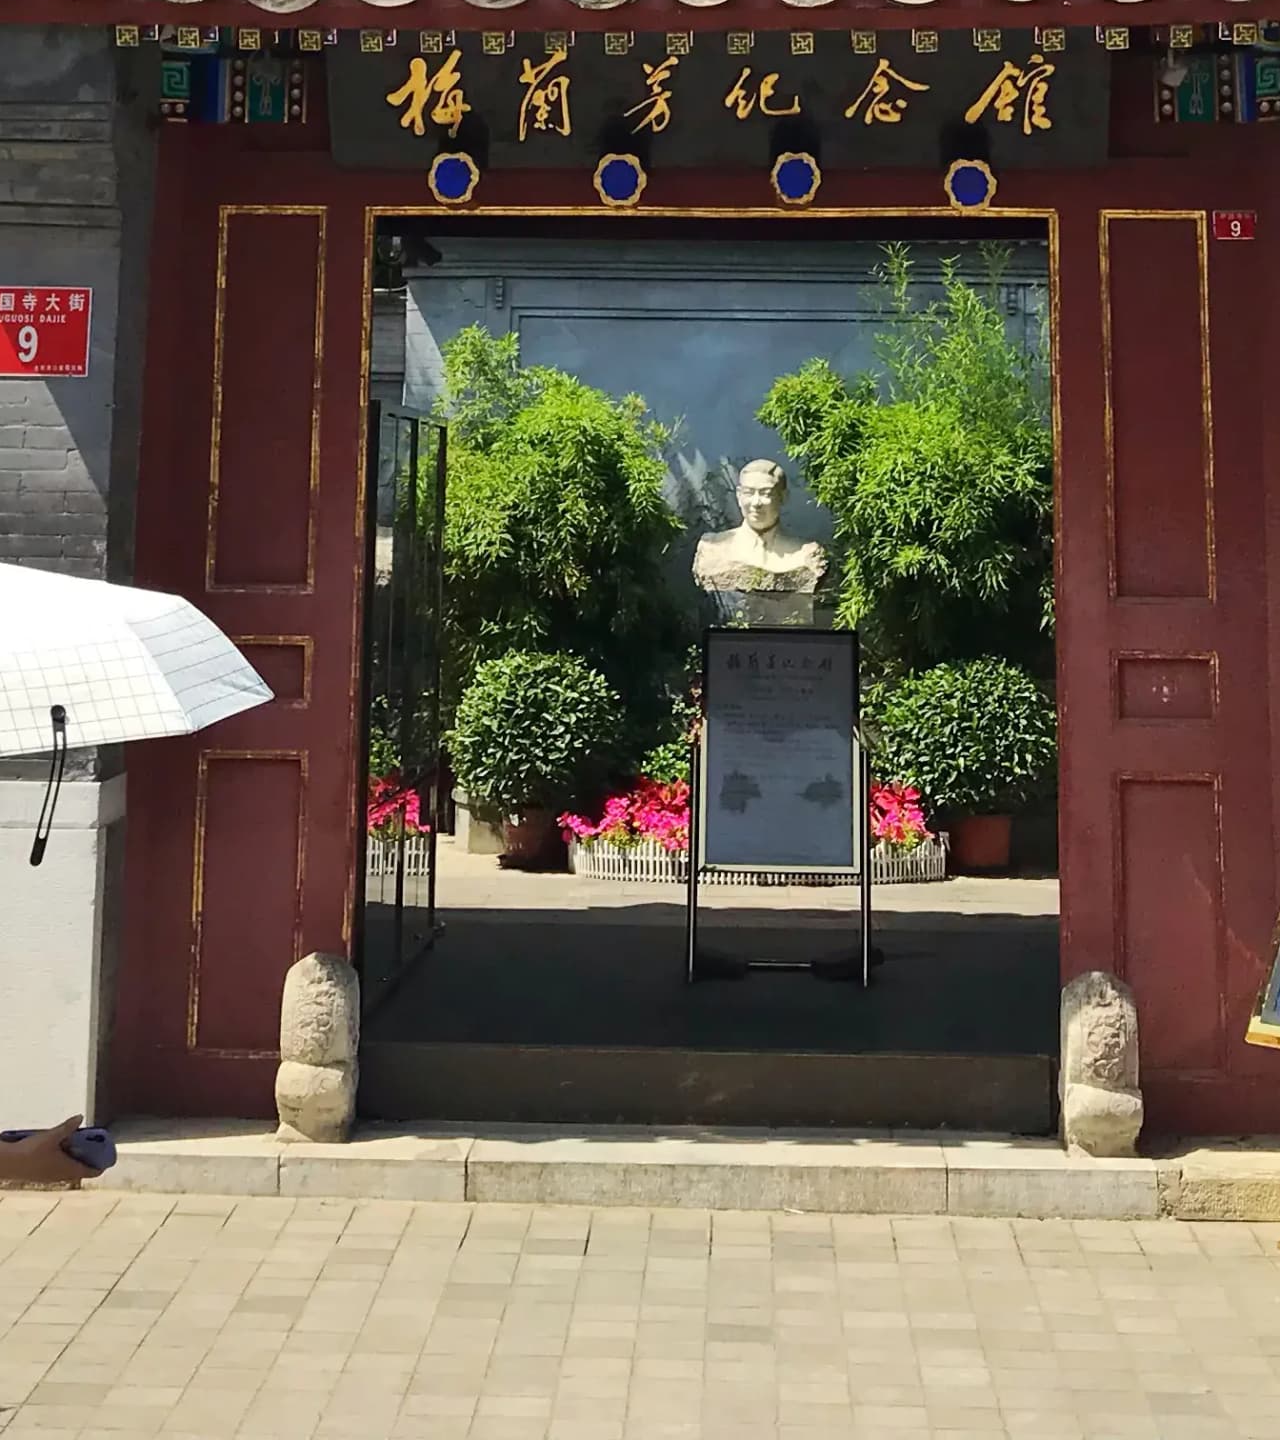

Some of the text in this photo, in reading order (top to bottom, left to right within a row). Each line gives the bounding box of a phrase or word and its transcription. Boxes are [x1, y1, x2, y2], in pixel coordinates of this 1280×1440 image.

[1231, 220, 1241, 237] 9
[39, 314, 67, 324] DAJIE
[18, 325, 39, 363] 9
